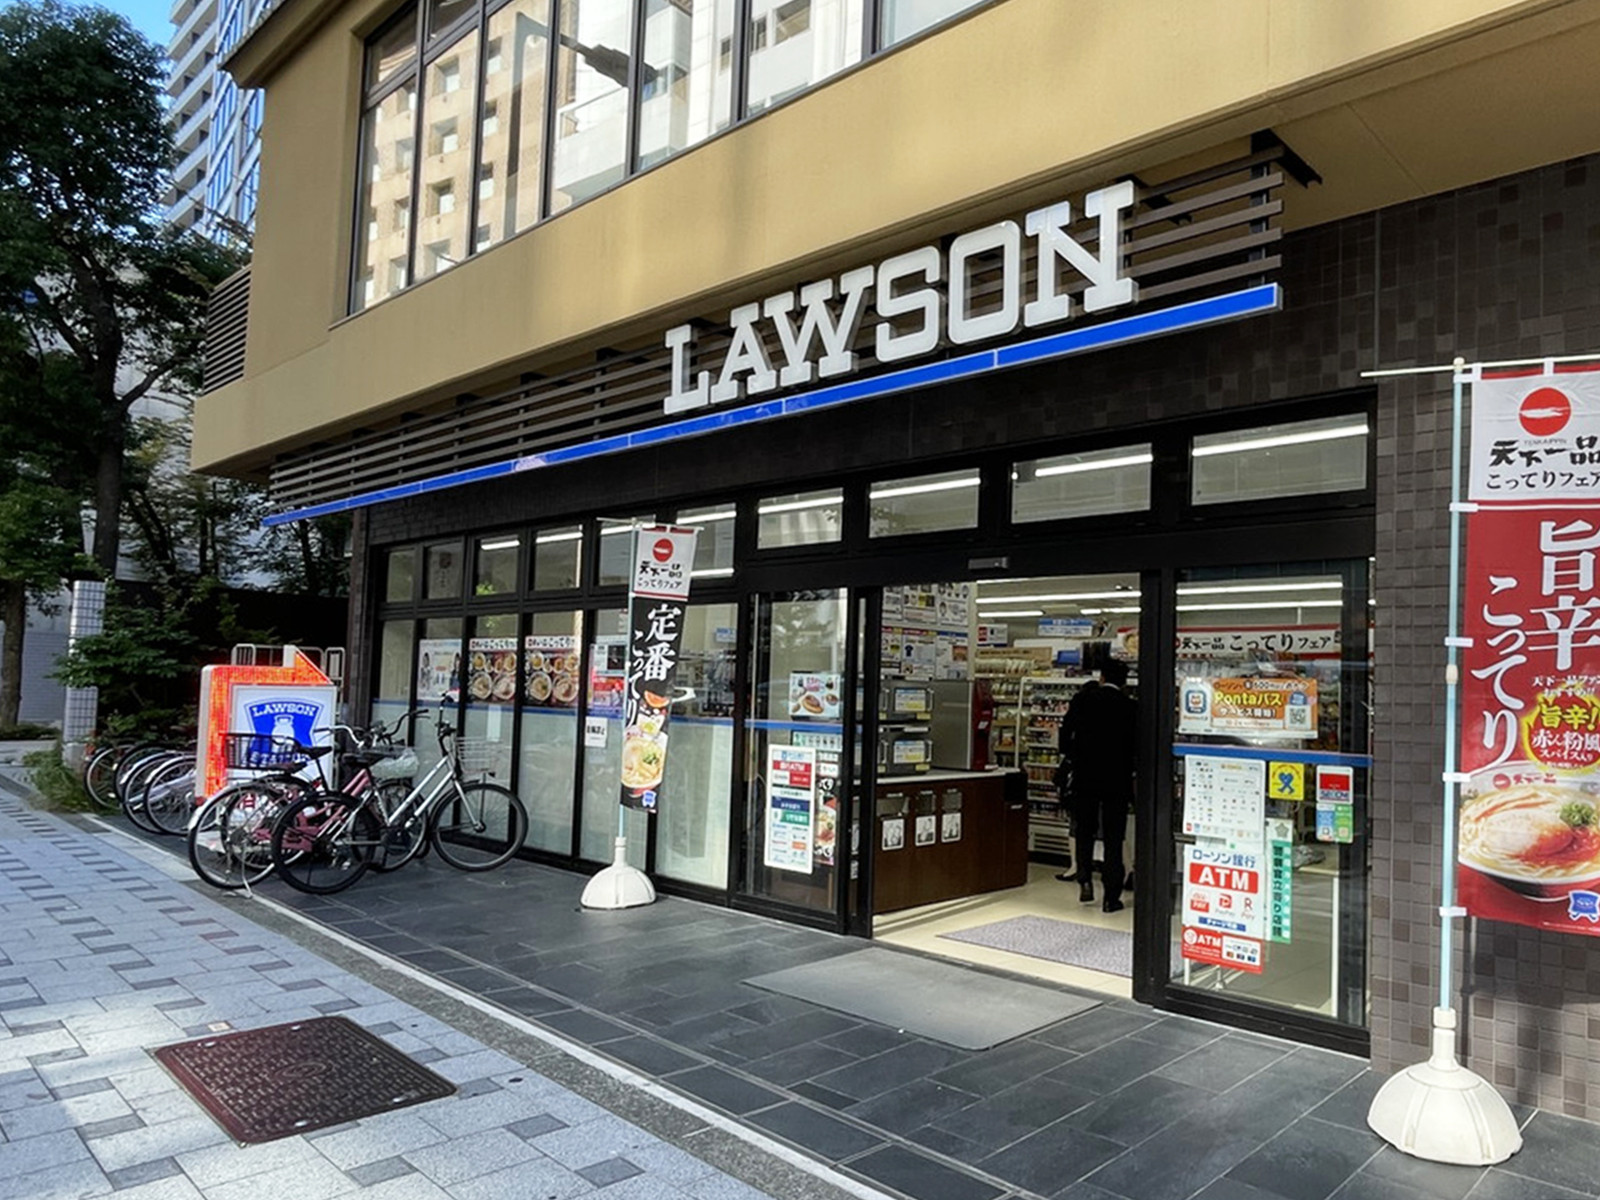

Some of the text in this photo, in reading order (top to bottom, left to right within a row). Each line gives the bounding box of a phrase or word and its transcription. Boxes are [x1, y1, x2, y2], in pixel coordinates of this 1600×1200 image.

[664, 180, 1138, 415] LAWSON
[1489, 435, 1600, 468] 天下一品
[1486, 470, 1600, 490] こってりフェア
[1525, 519, 1600, 672] 旨辛
[643, 603, 681, 681] 定番
[1229, 633, 1331, 651] こってりフェア
[1470, 574, 1528, 776] こってり
[251, 703, 317, 717] LAWSON
[1192, 848, 1256, 869] ローソン銀行
[1198, 866, 1250, 891] ATM
[1197, 934, 1222, 947] ATM
